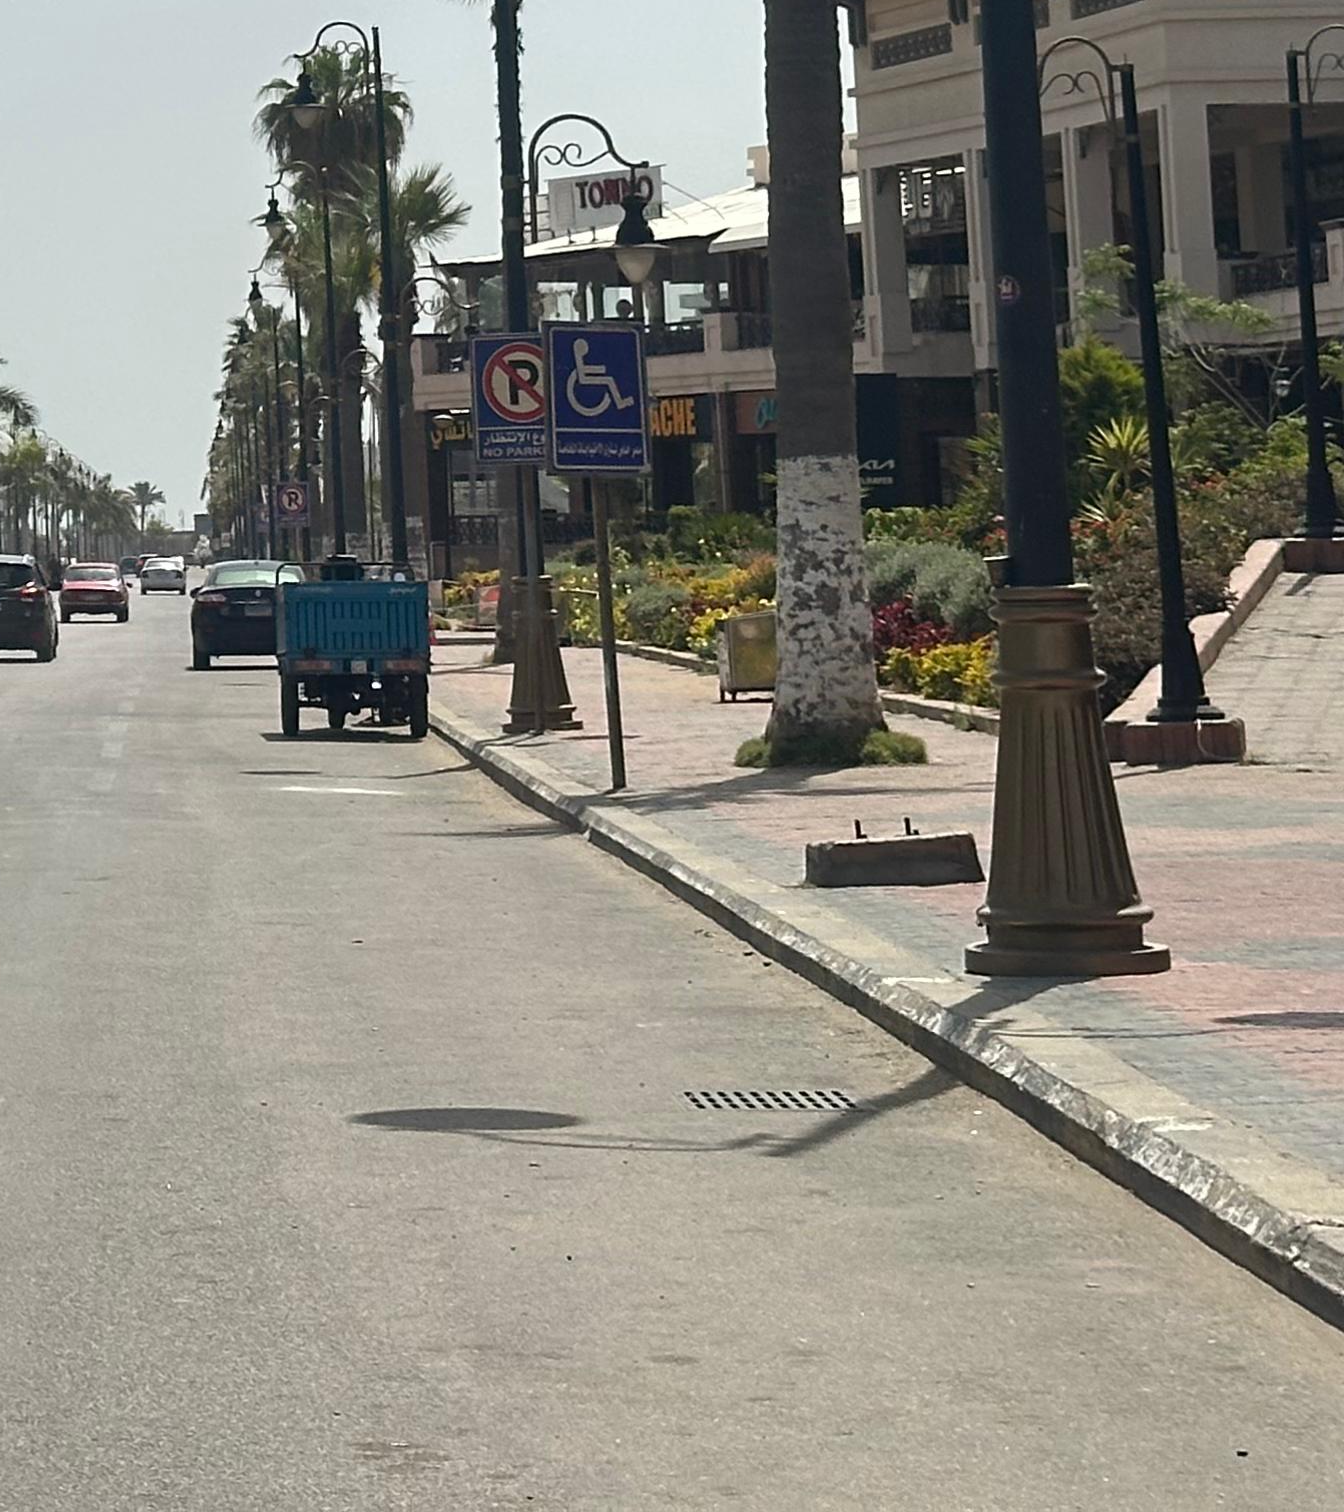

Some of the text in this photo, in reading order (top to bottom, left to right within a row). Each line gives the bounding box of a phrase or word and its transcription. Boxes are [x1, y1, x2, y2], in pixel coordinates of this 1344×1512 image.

[650, 396, 696, 437] ACHE
[483, 447, 545, 457] NO PARK
